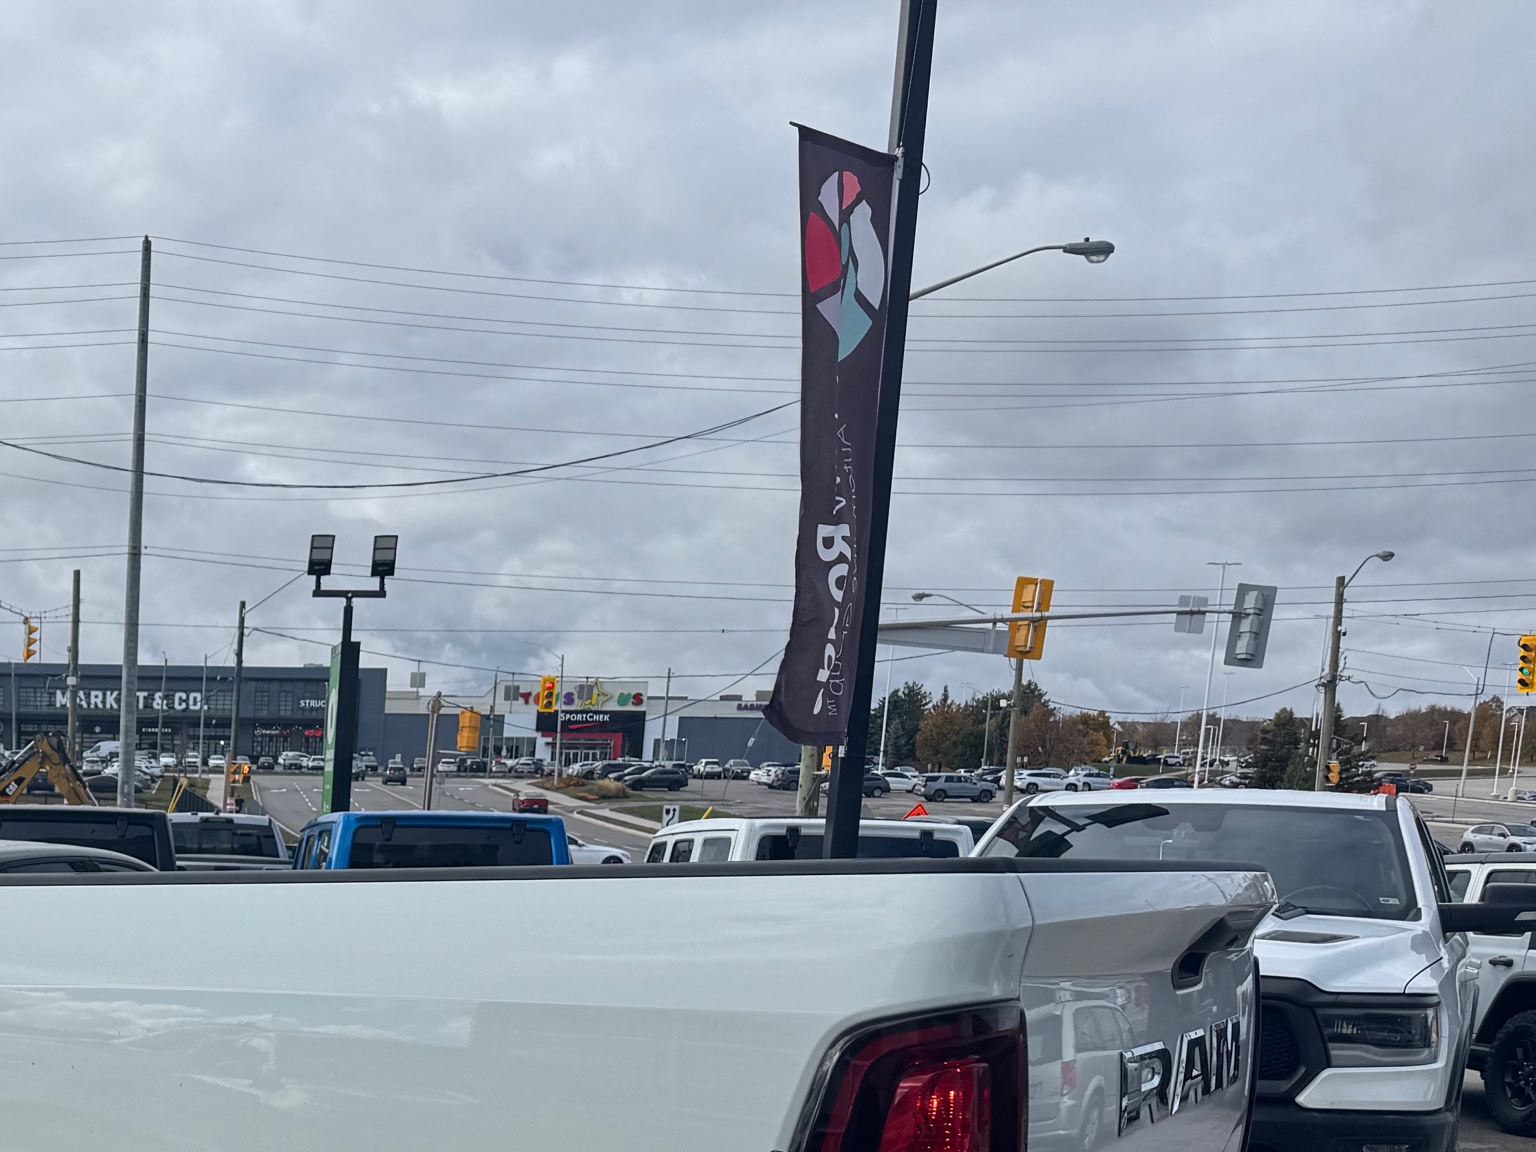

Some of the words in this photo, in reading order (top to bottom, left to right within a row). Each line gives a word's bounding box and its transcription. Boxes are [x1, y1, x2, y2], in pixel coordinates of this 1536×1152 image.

[55, 690, 149, 709] MARKT
[152, 692, 168, 710] &
[300, 699, 326, 708] STRUC
[616, 692, 644, 707] US
[5, 781, 19, 796] CAT
[1117, 1015, 1241, 1137] RAM
